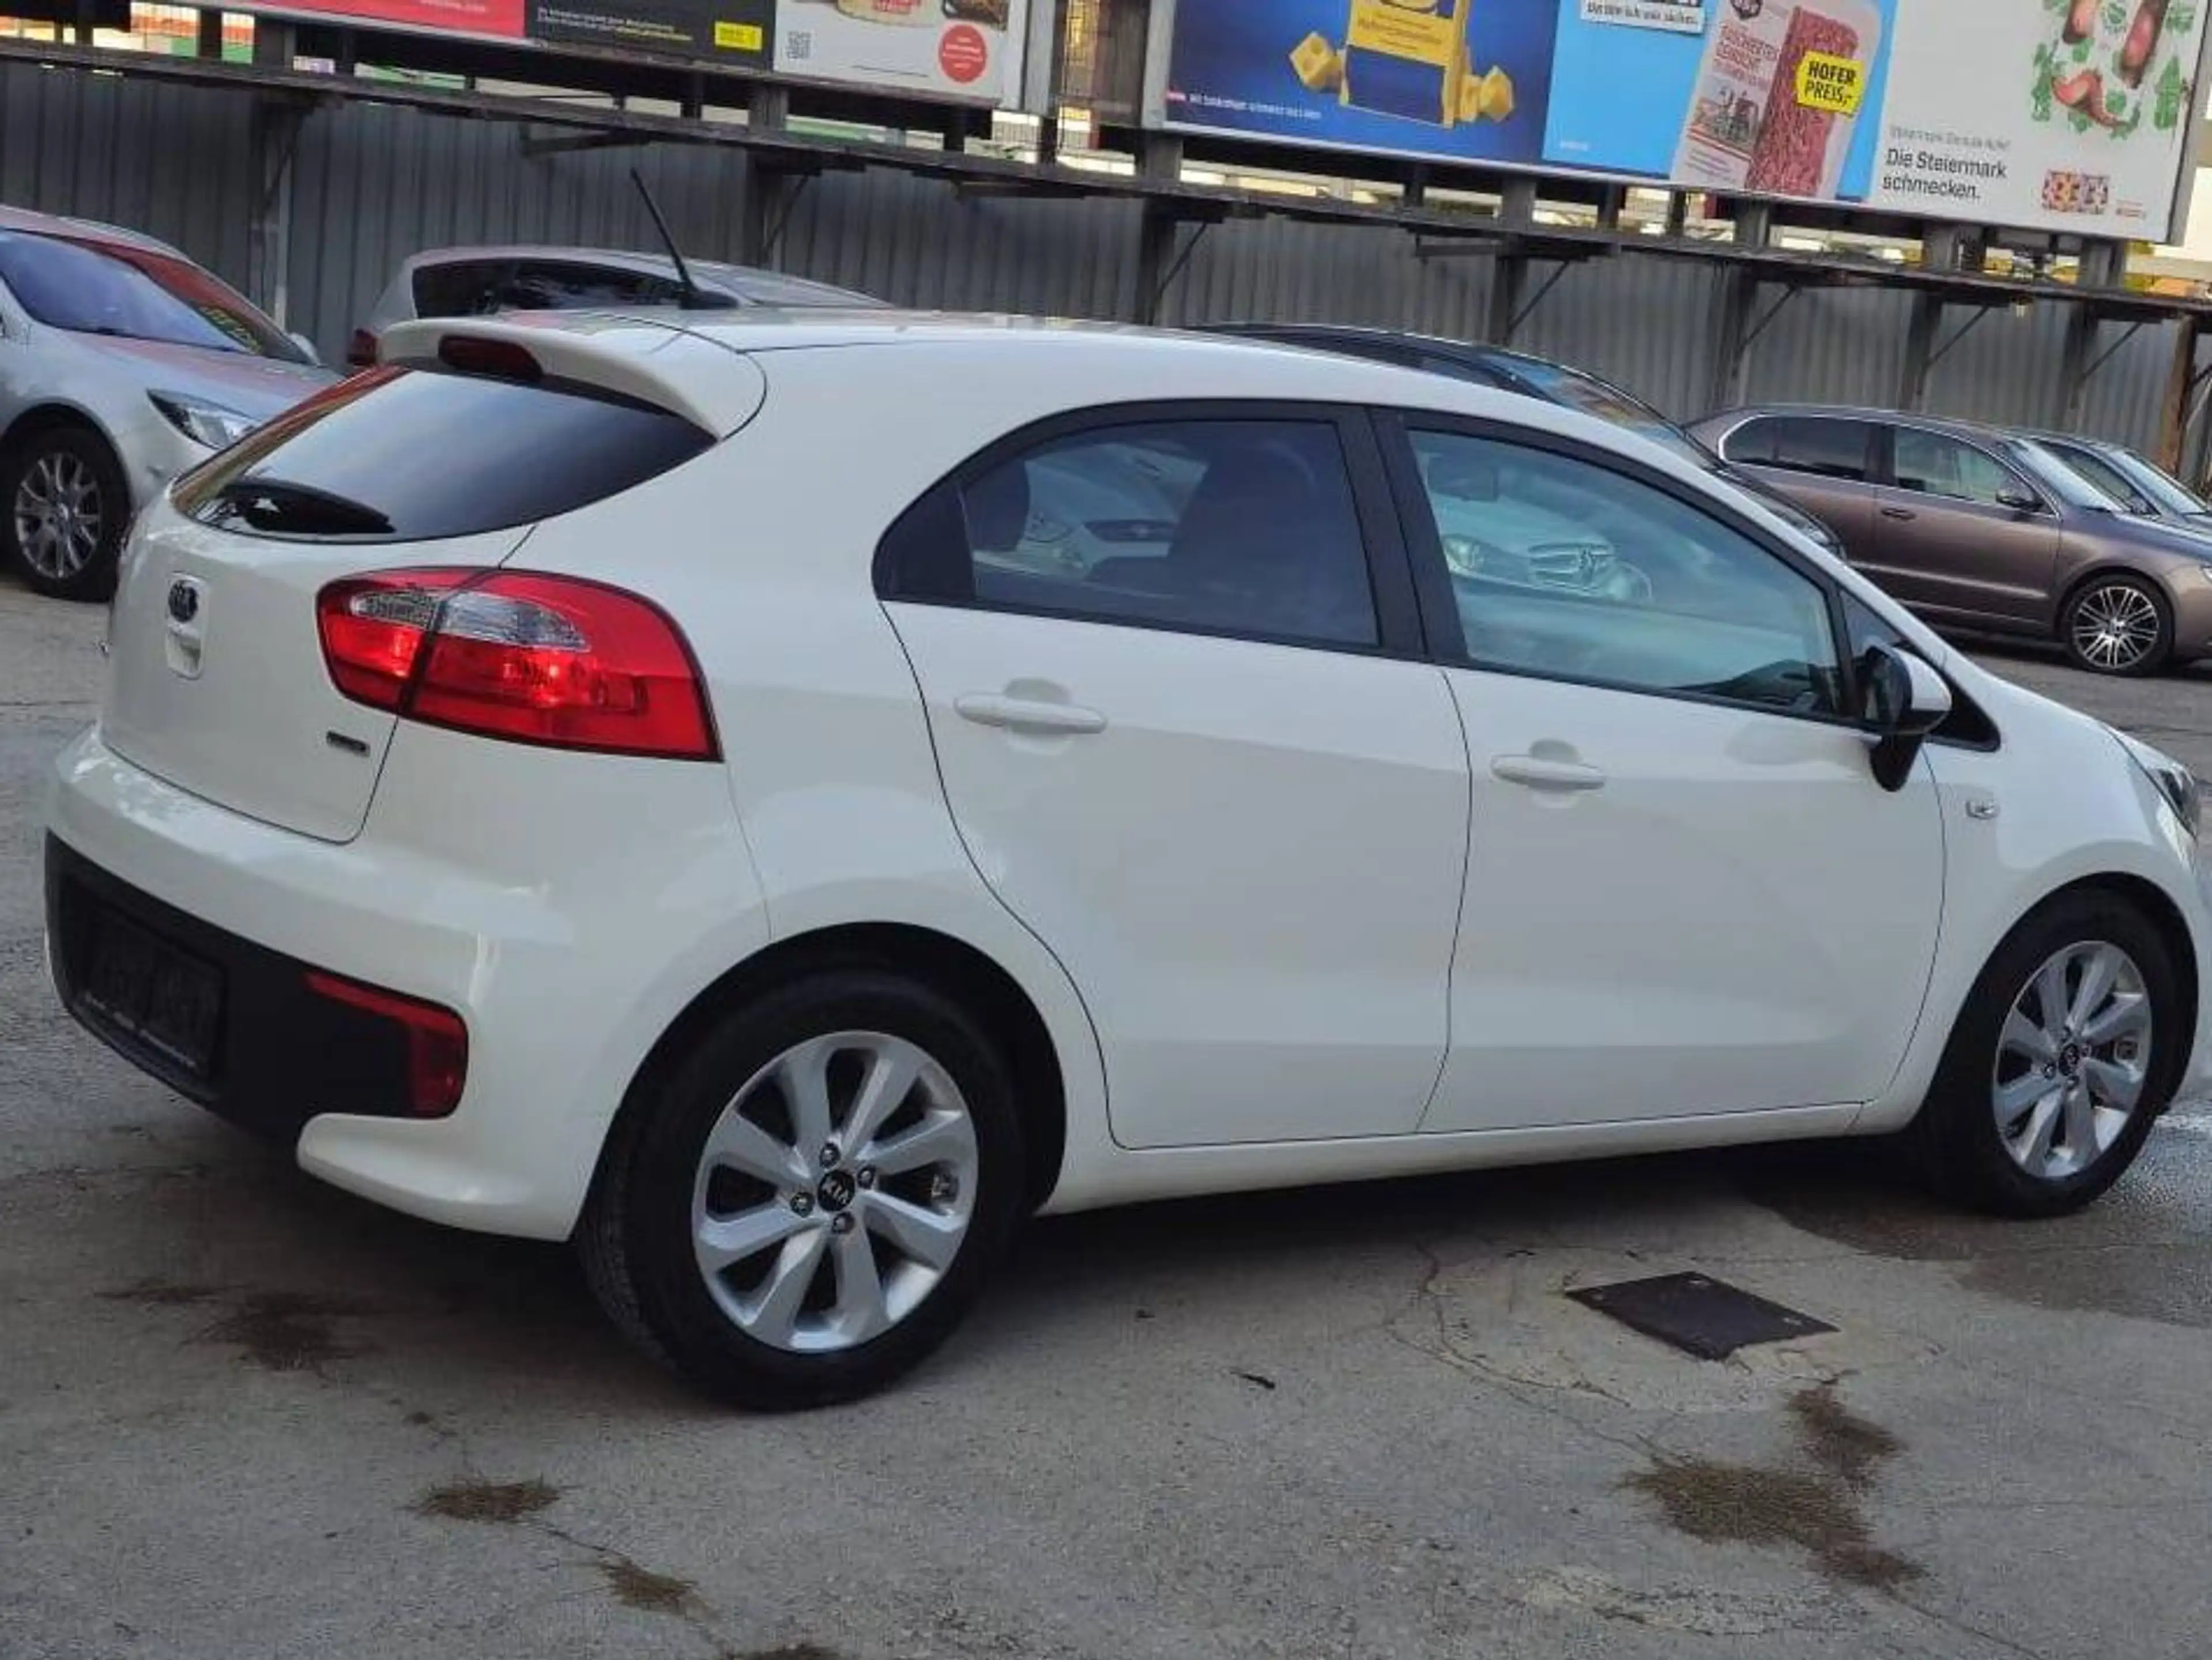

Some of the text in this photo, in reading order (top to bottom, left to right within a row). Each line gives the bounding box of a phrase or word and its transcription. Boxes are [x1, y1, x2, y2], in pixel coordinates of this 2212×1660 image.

[1808, 61, 1855, 86] HOFER
[1886, 148, 2008, 178] Die Steiermark
[1882, 174, 1981, 199] schmecken.
